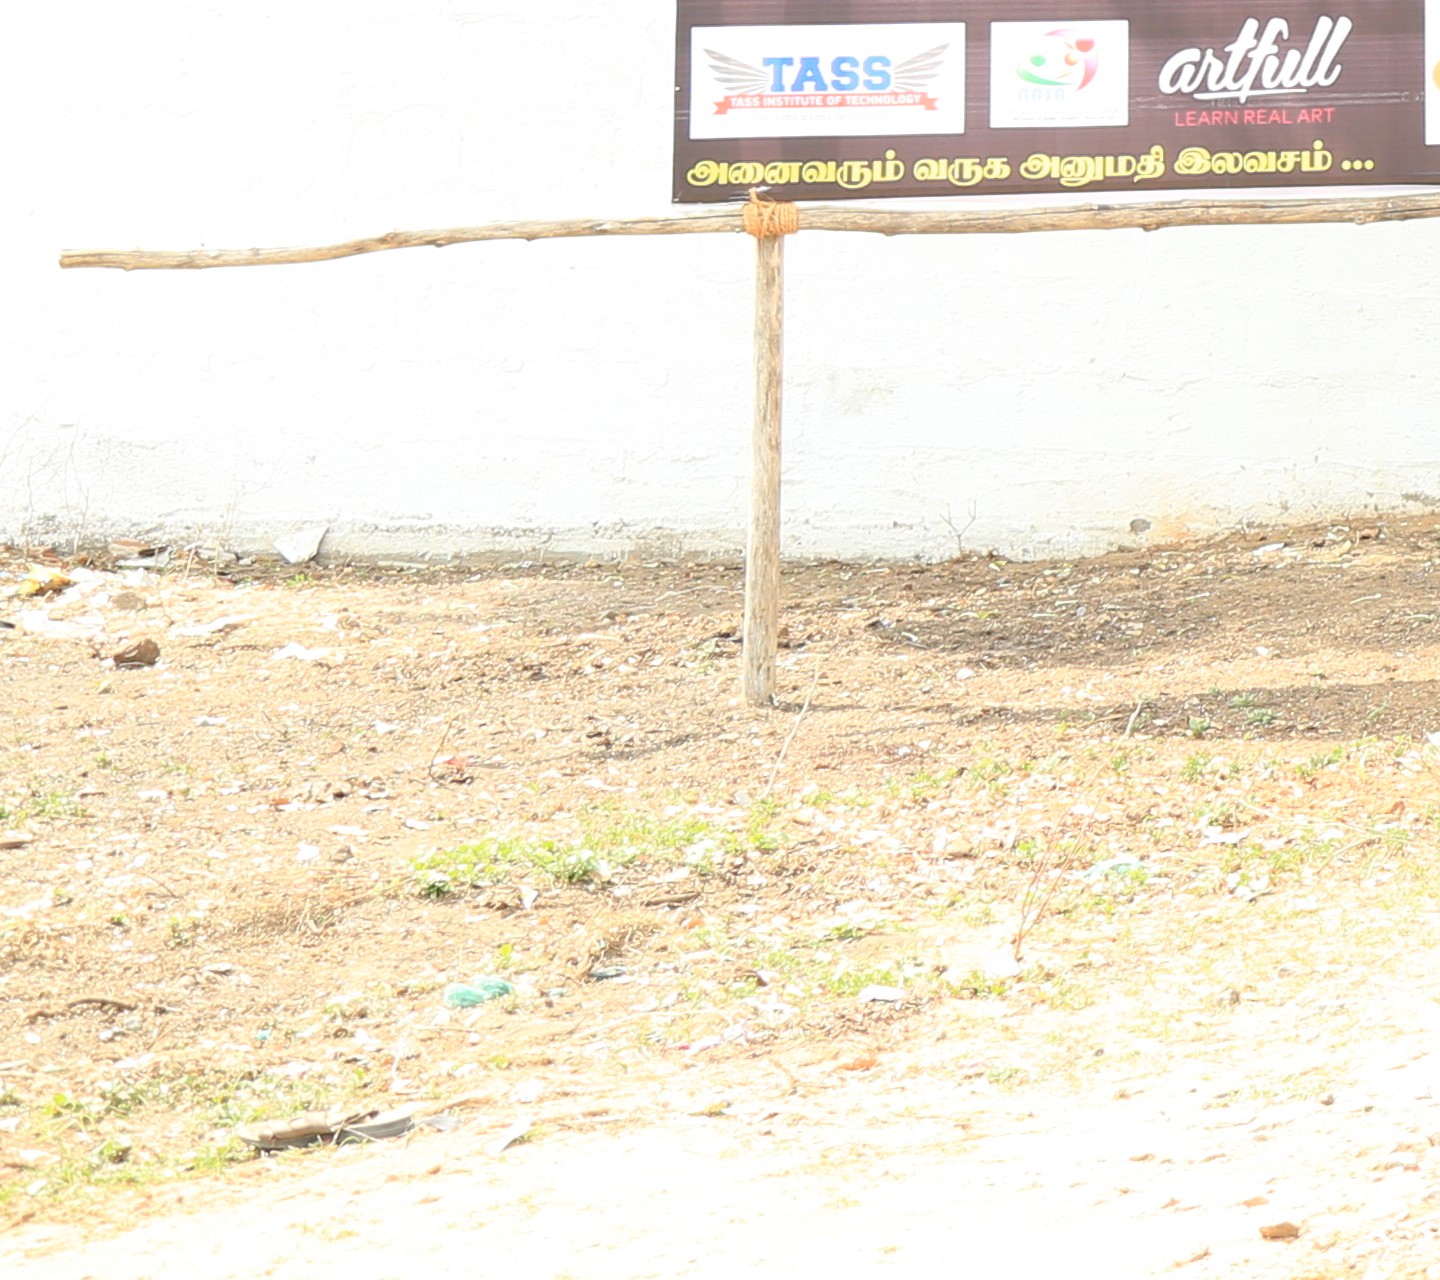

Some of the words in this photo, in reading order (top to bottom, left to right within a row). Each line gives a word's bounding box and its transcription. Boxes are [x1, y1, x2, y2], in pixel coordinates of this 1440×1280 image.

[762, 56, 891, 92] TASS
[1158, 16, 1352, 102] artfull
[730, 97, 760, 107] TASS
[763, 96, 822, 106] INSTITUTE
[827, 96, 841, 105] OF
[845, 94, 921, 105] TECHNOLOGY
[1175, 111, 1238, 127] LEARN
[1244, 109, 1291, 125] REAL
[1298, 108, 1336, 123] ART
[687, 150, 905, 189] அனைவரும்
[914, 157, 1011, 186] வருக
[1020, 146, 1164, 187] அனுமதி
